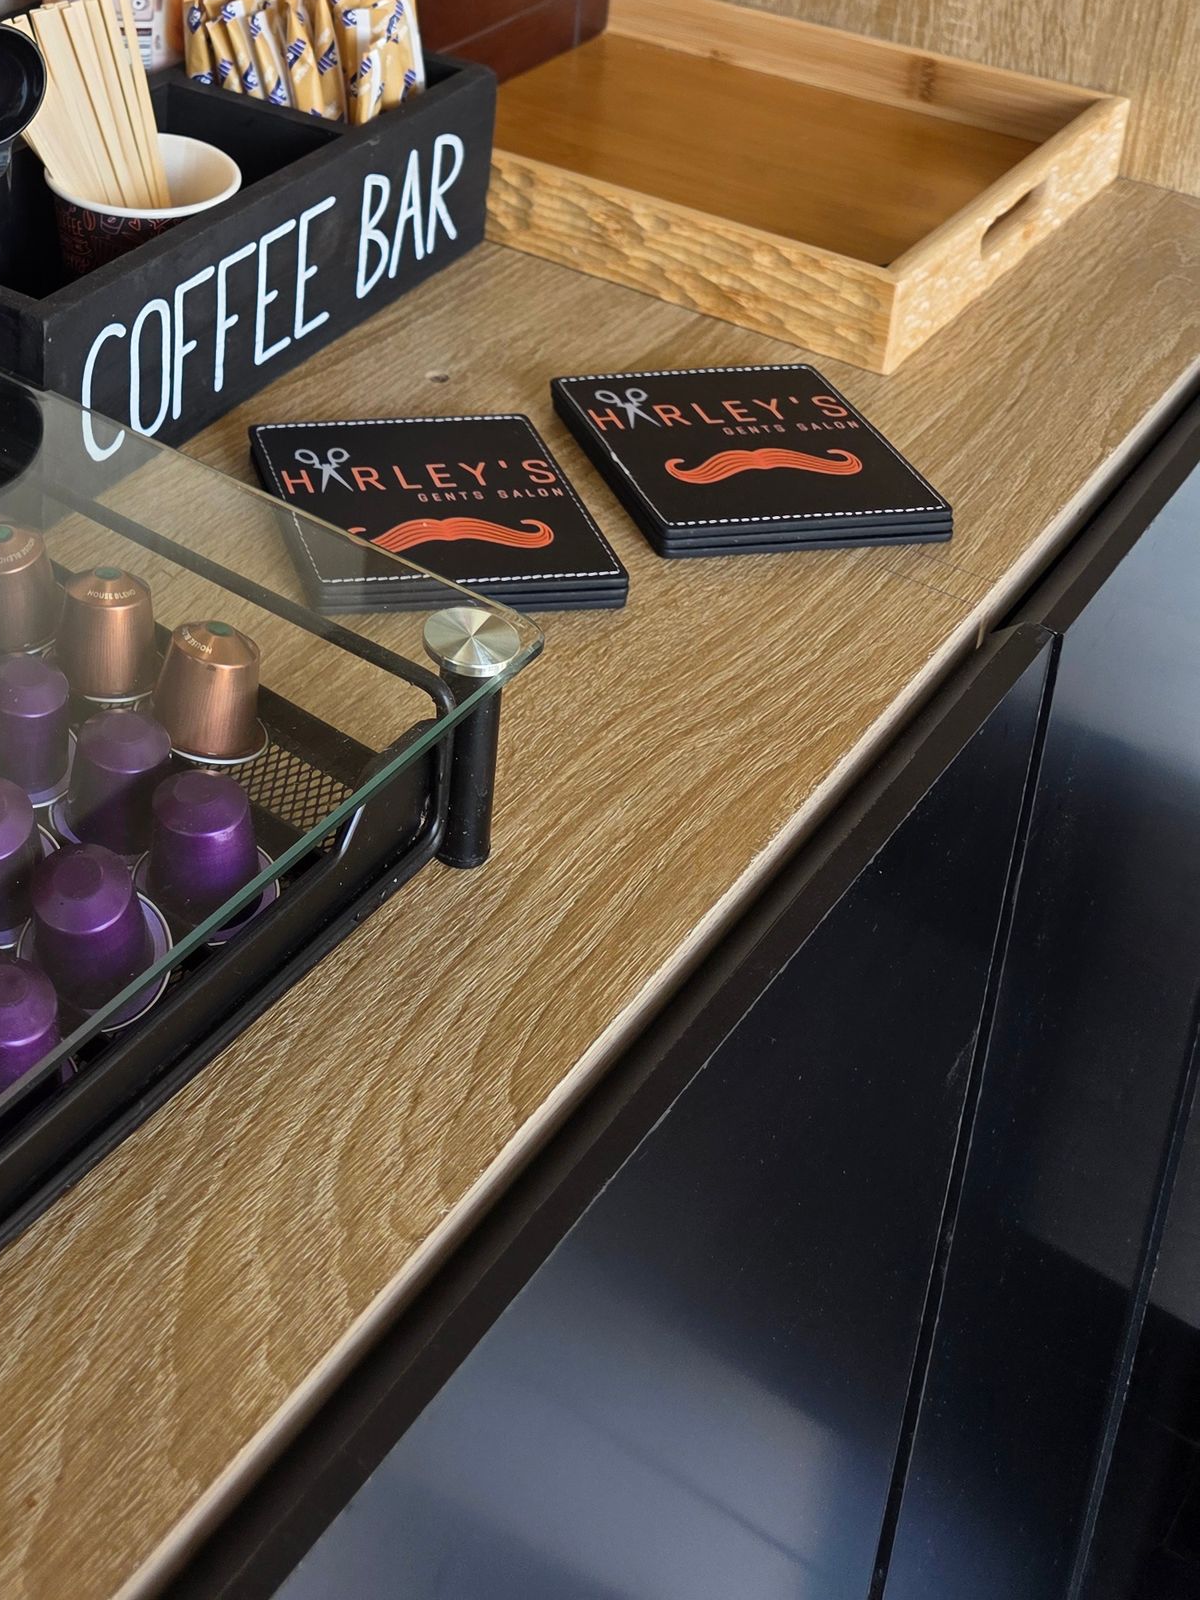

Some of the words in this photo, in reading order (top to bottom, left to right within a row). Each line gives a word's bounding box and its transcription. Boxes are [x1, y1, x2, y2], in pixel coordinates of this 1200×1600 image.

[81, 195, 337, 462] COFFEE
[355, 132, 465, 300] BAR
[721, 424, 786, 437] GENTS
[795, 419, 861, 433] SALON
[417, 490, 485, 503] GENTS
[498, 486, 565, 500] SALON
